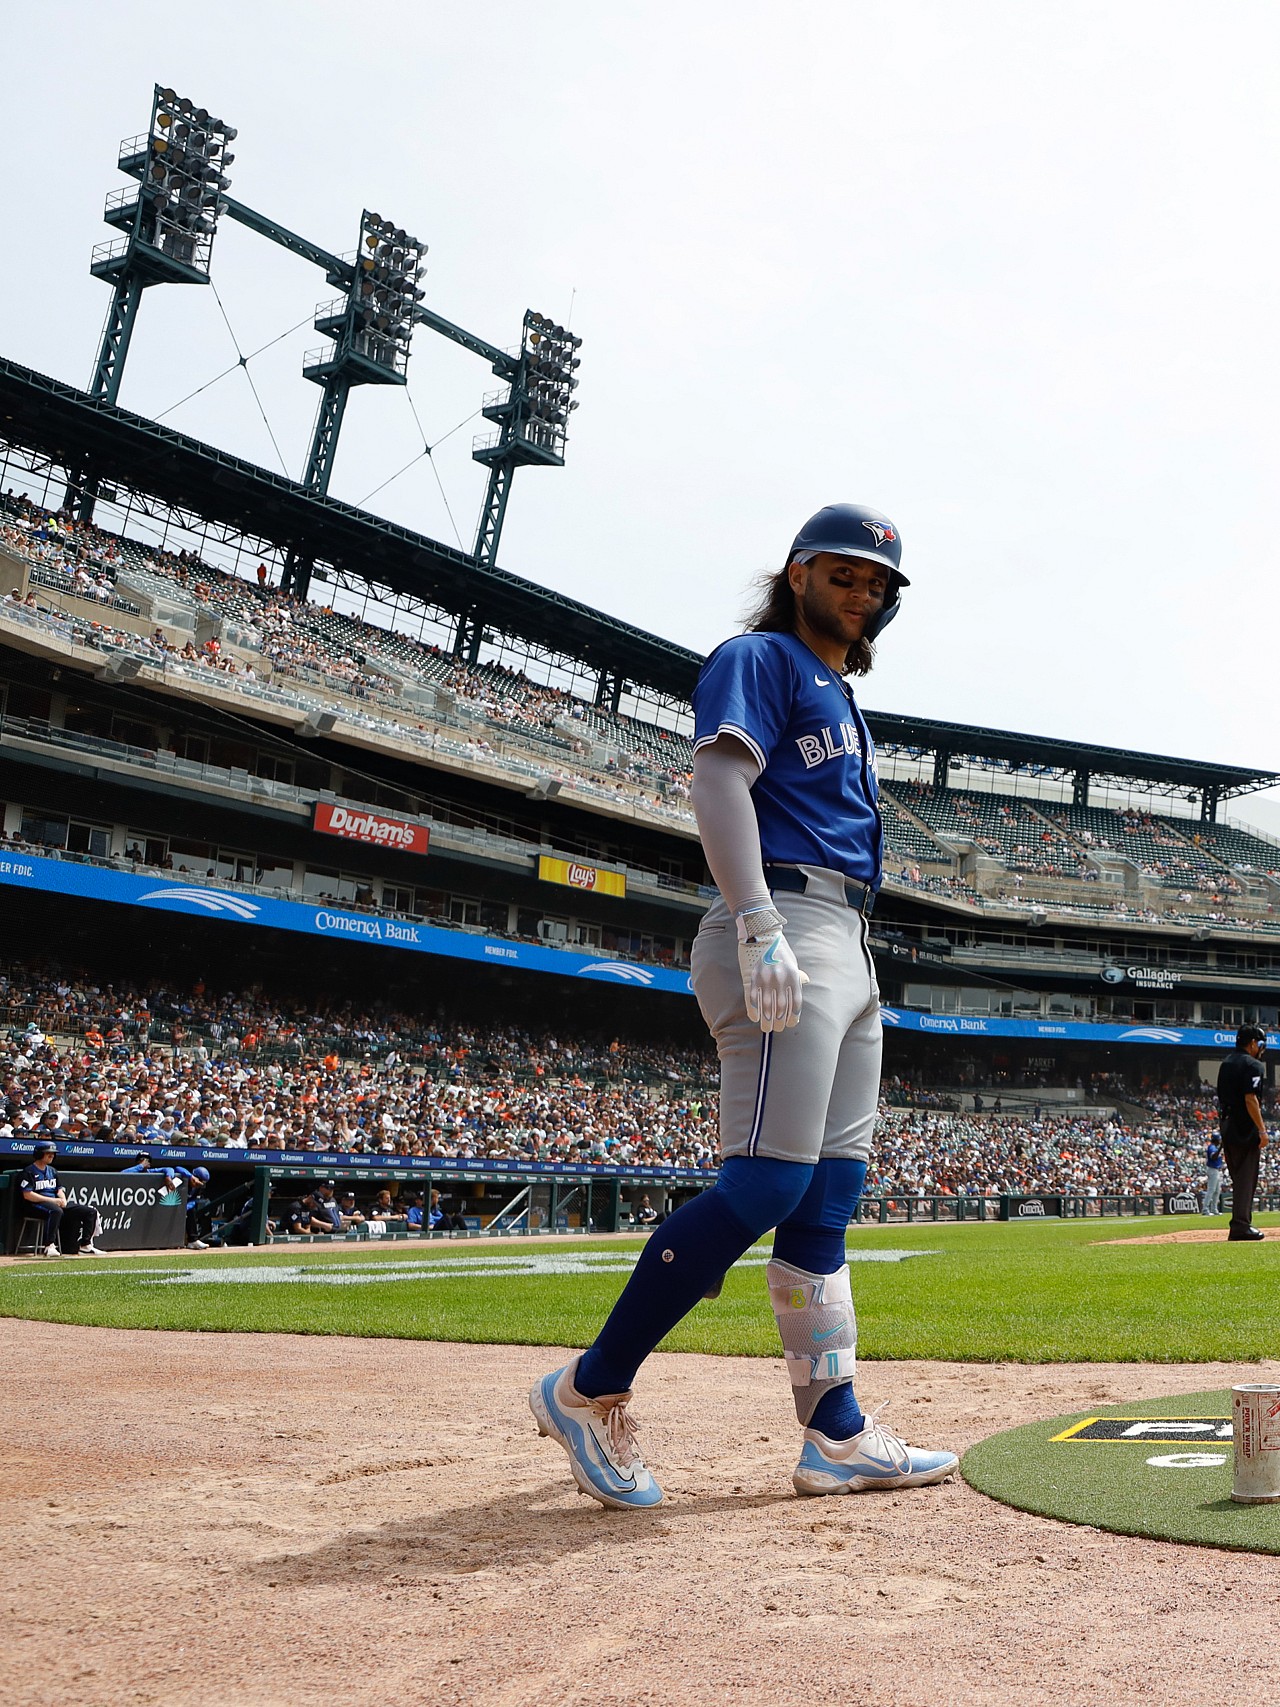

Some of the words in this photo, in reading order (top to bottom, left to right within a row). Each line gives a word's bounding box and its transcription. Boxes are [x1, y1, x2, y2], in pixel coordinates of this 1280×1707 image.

[329, 807, 415, 844] Dunham's
[337, 830, 405, 849] SPORTS
[13, 863, 34, 878] FDIC.
[569, 863, 596, 888] Lay's
[484, 945, 505, 956] MEMBER
[1127, 966, 1183, 982] Gallagher
[1136, 980, 1174, 989] INSURANCE
[1028, 1057, 1056, 1068] MARKET
[72, 1145, 95, 1155] McLaren
[166, 1149, 186, 1158] McLaren
